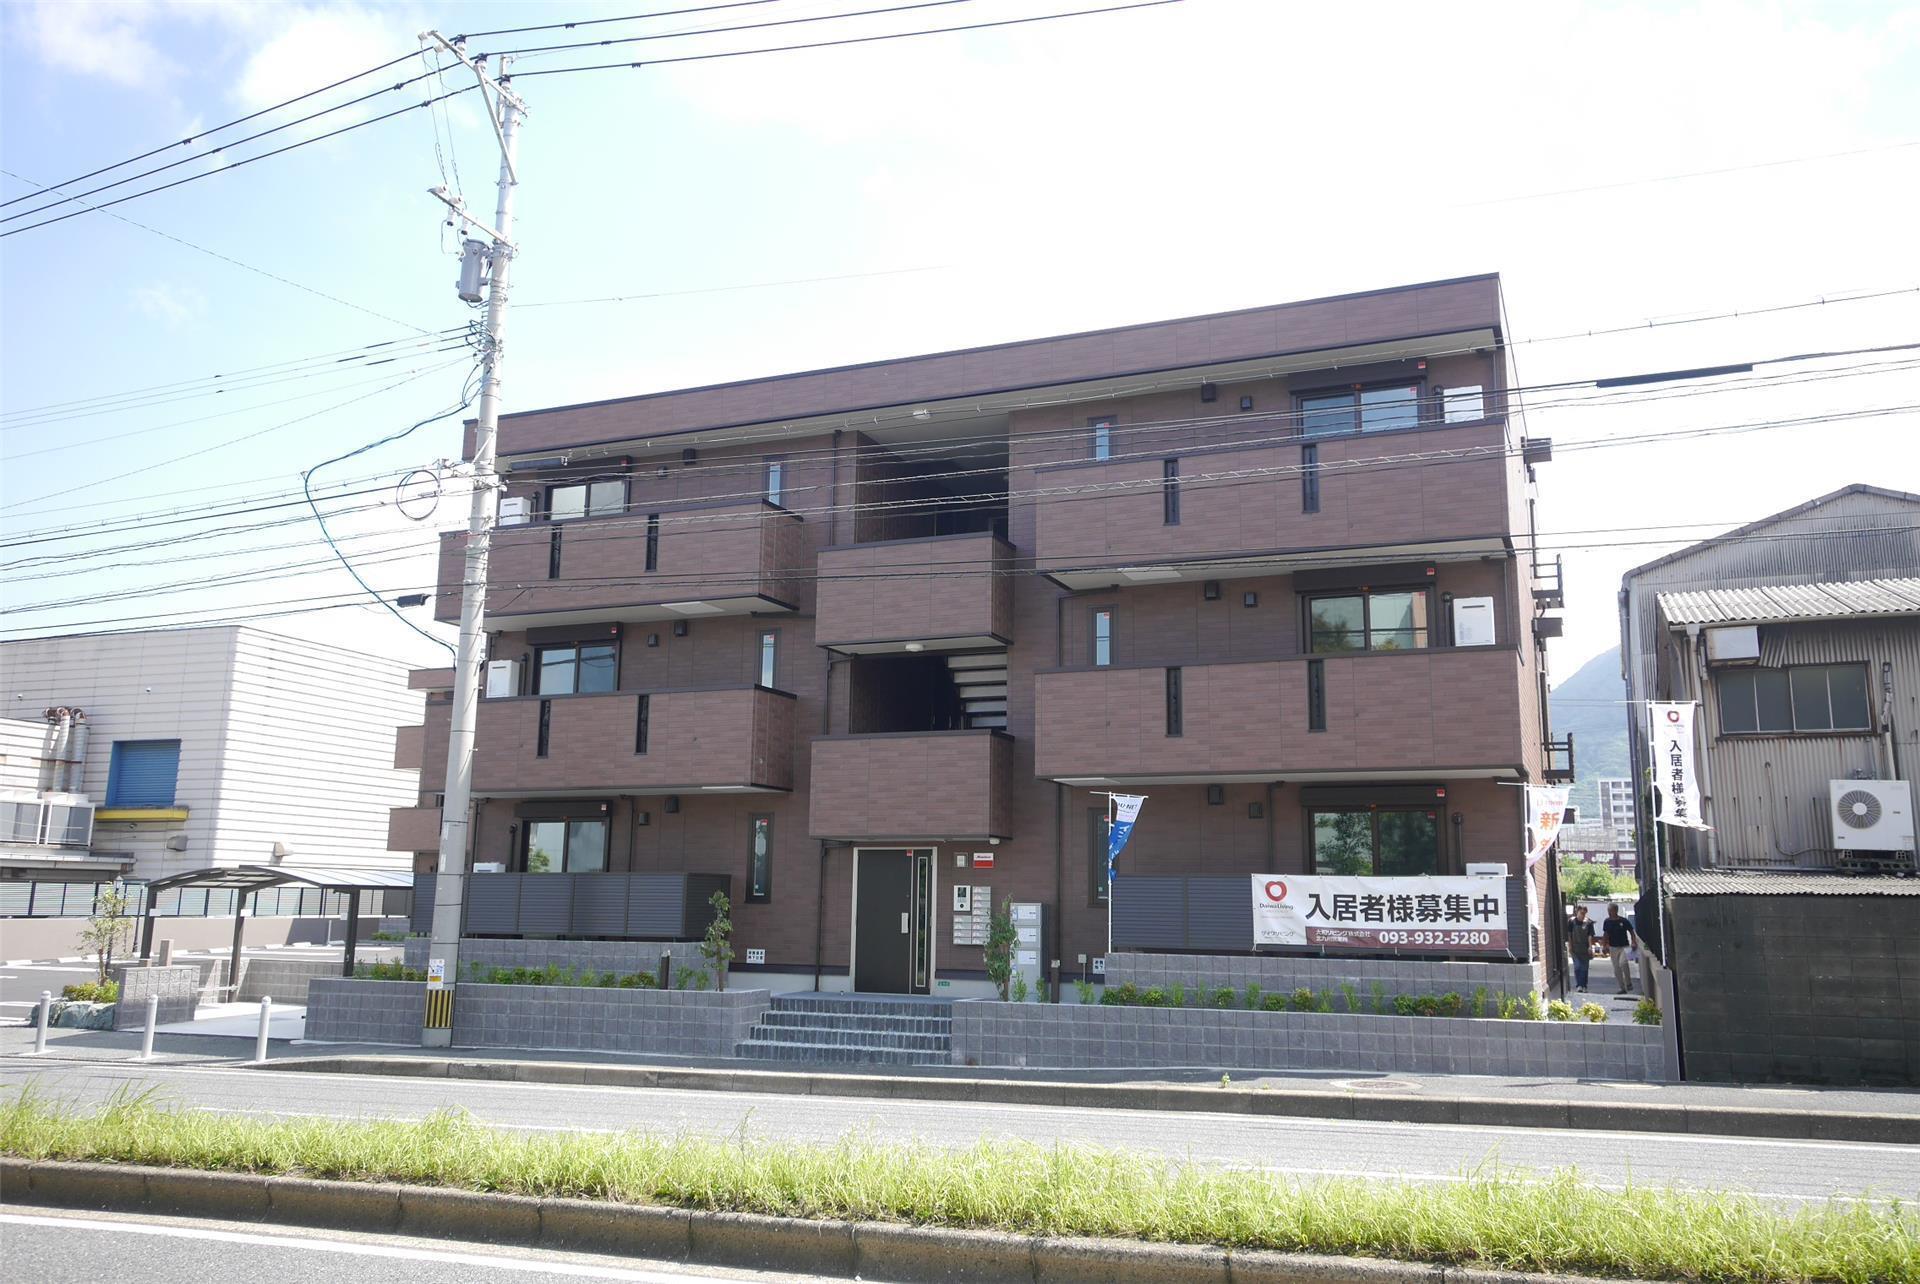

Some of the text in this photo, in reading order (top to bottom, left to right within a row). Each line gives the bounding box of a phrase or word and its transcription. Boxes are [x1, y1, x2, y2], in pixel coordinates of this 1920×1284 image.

[1305, 893, 1500, 923] 入居者様募集中
[1378, 931, 1490, 945] 093-932-5280
